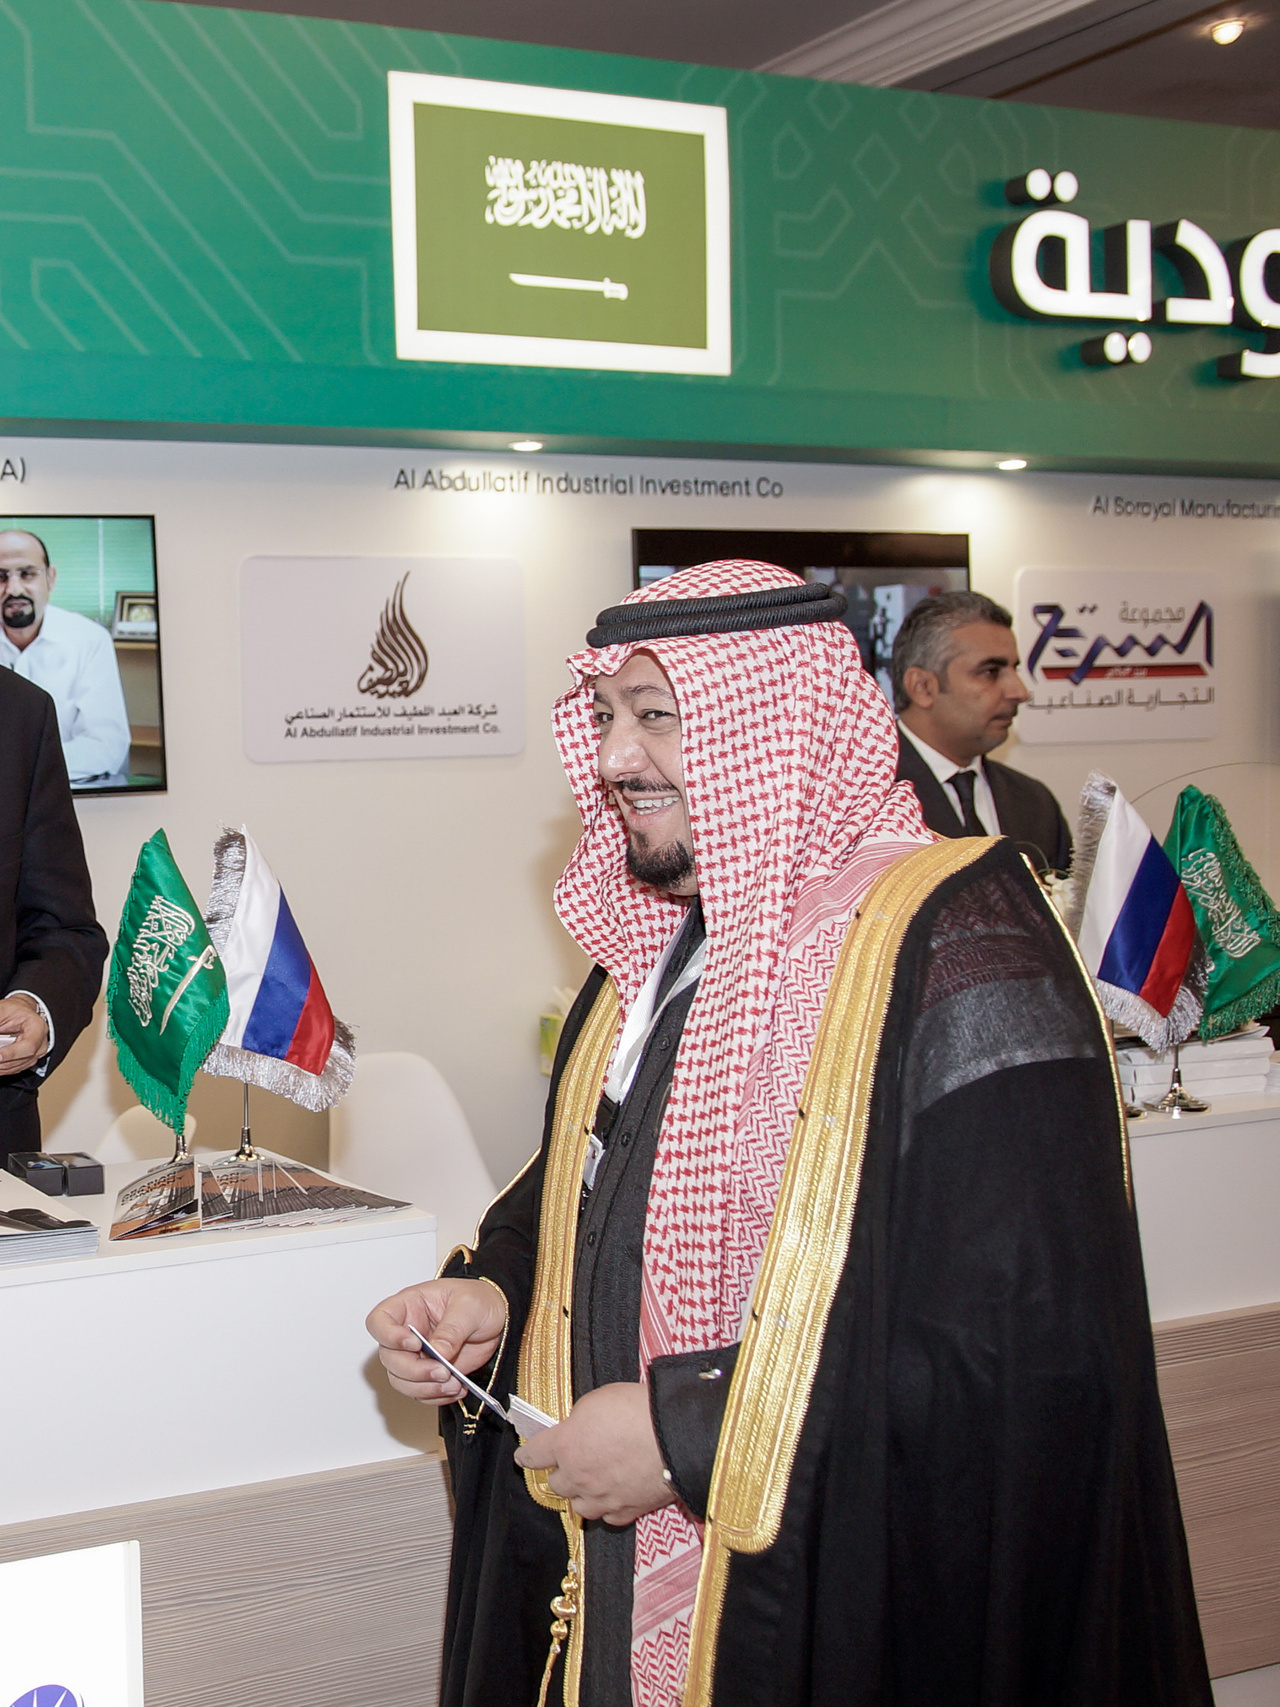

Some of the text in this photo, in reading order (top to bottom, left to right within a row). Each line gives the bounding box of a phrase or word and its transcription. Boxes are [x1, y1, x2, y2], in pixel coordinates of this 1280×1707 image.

[393, 469, 784, 499] Al Abdullatif Industrial Investment Co
[284, 726, 297, 739] Al
[300, 725, 358, 738] Abdullatif
[361, 724, 415, 737] Industrial
[418, 723, 479, 736] Investment
